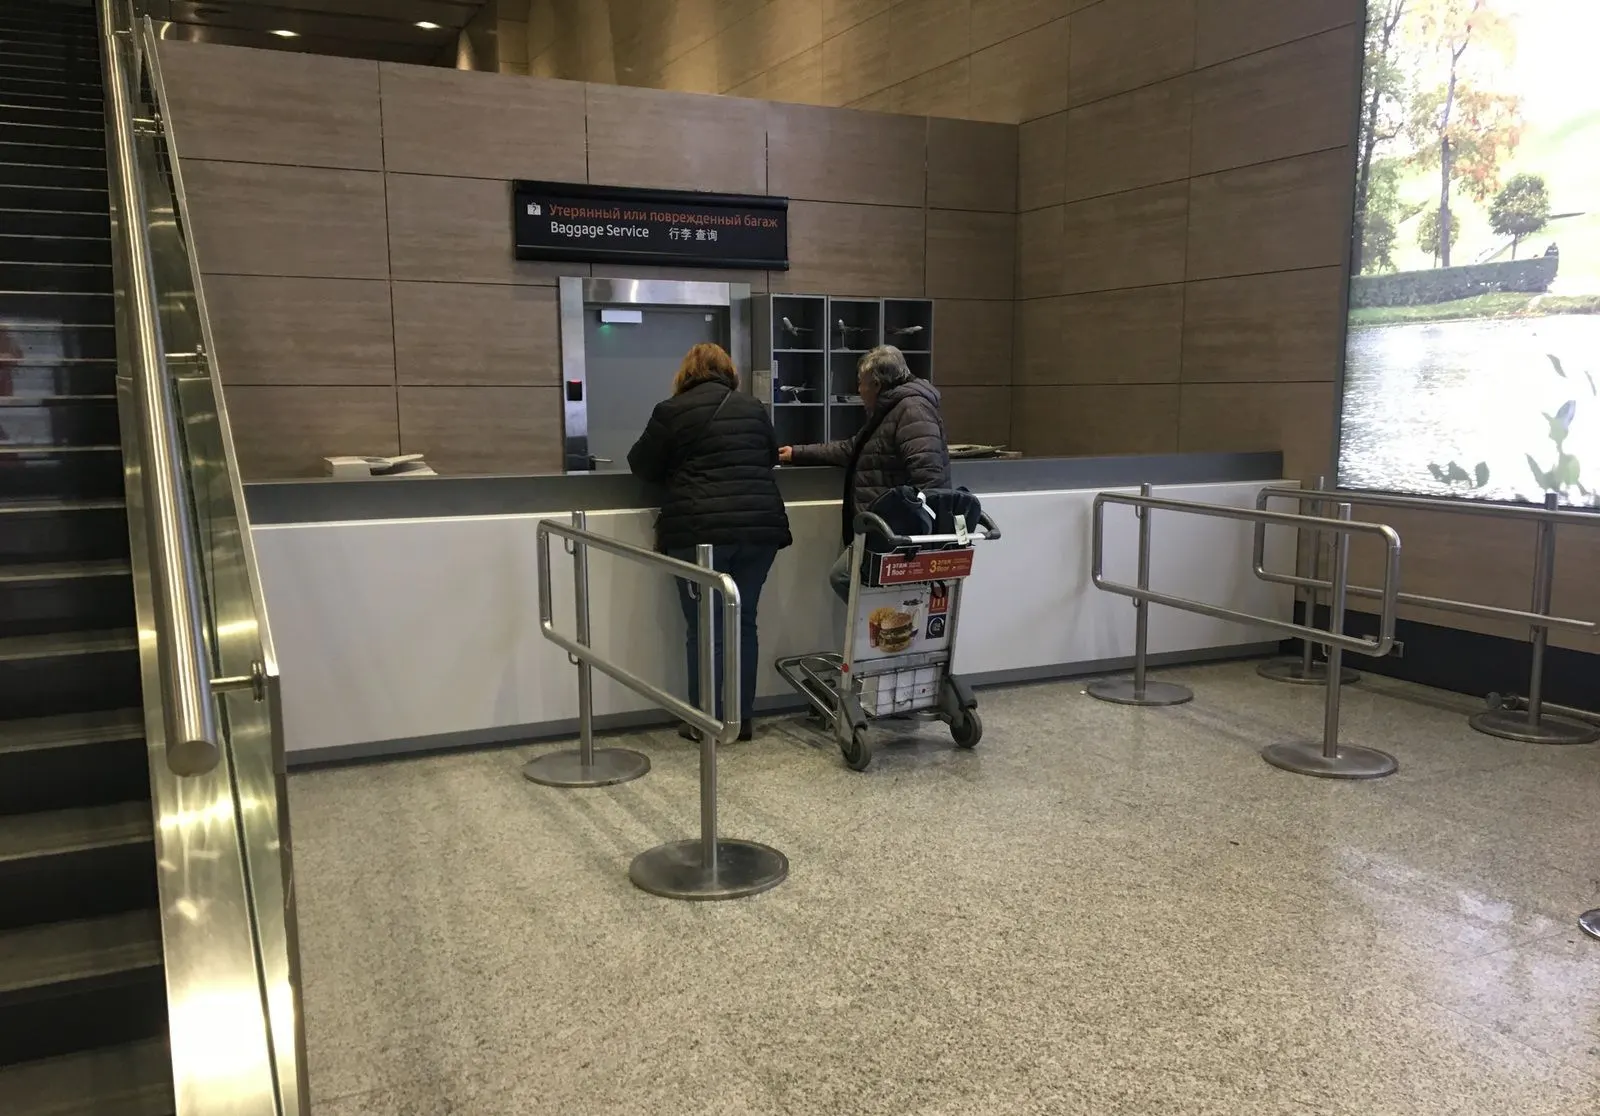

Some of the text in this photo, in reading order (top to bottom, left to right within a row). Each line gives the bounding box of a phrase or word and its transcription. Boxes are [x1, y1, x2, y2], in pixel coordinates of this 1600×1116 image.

[549, 204, 778, 228] Утерянный или поврежденный багаж
[550, 221, 649, 239] Baggage Service
[669, 227, 718, 241] 行李 查询
[885, 563, 892, 577] 1
[891, 568, 906, 576] floor
[929, 559, 937, 573] 3
